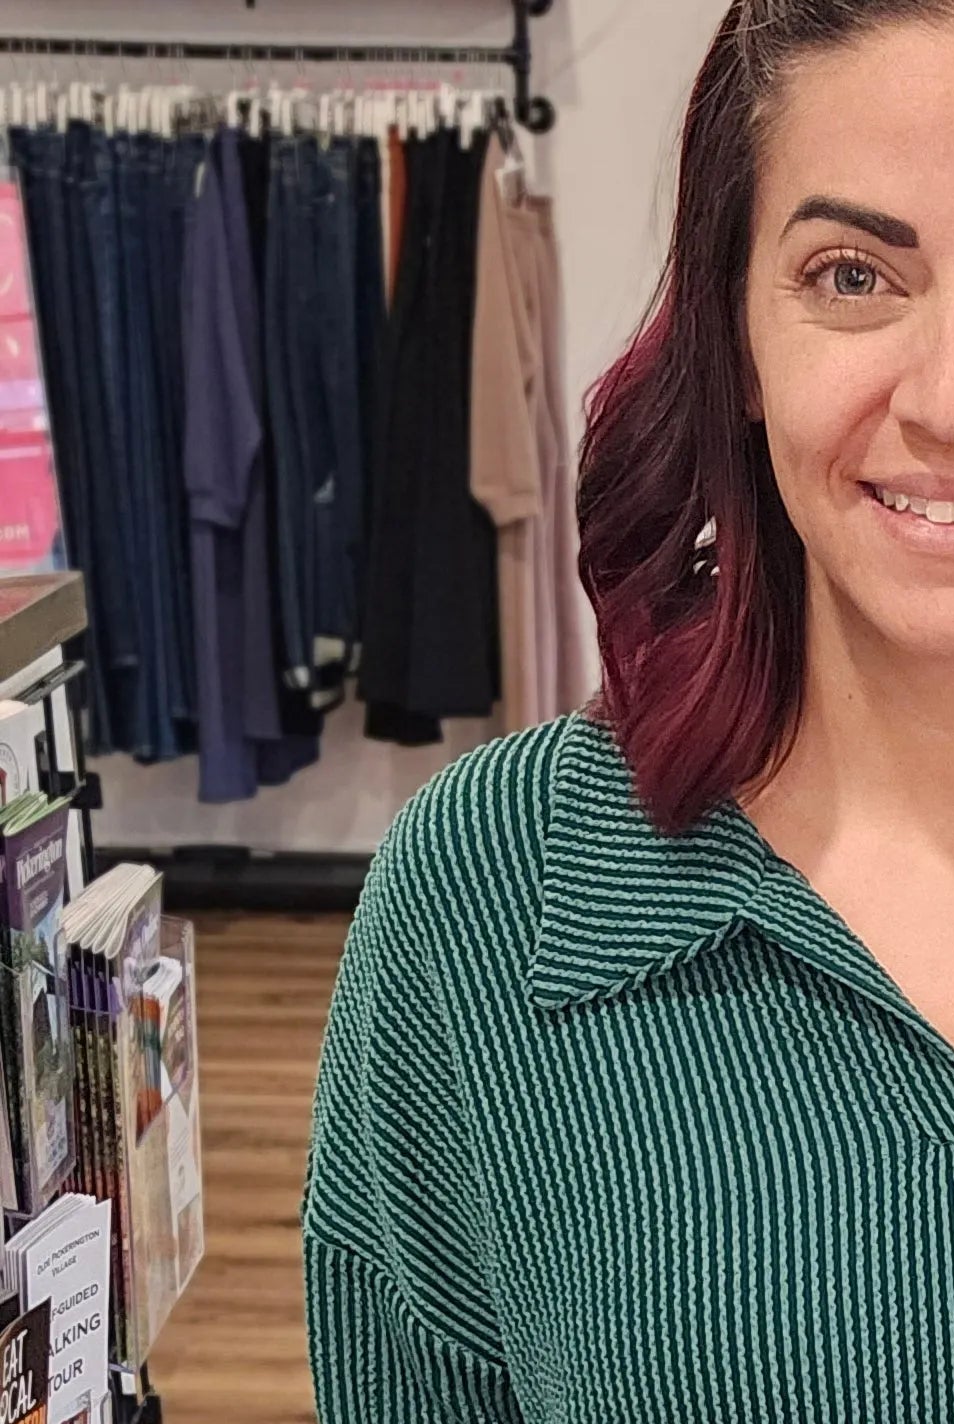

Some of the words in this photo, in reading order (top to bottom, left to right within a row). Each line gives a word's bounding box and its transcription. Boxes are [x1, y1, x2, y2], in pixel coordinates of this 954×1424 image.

[51, 1229, 100, 1264] PICKERINGTON
[51, 1255, 77, 1277] VILLAGE
[3, 1329, 28, 1388] EAT
[48, 1358, 83, 1397] TOUR
